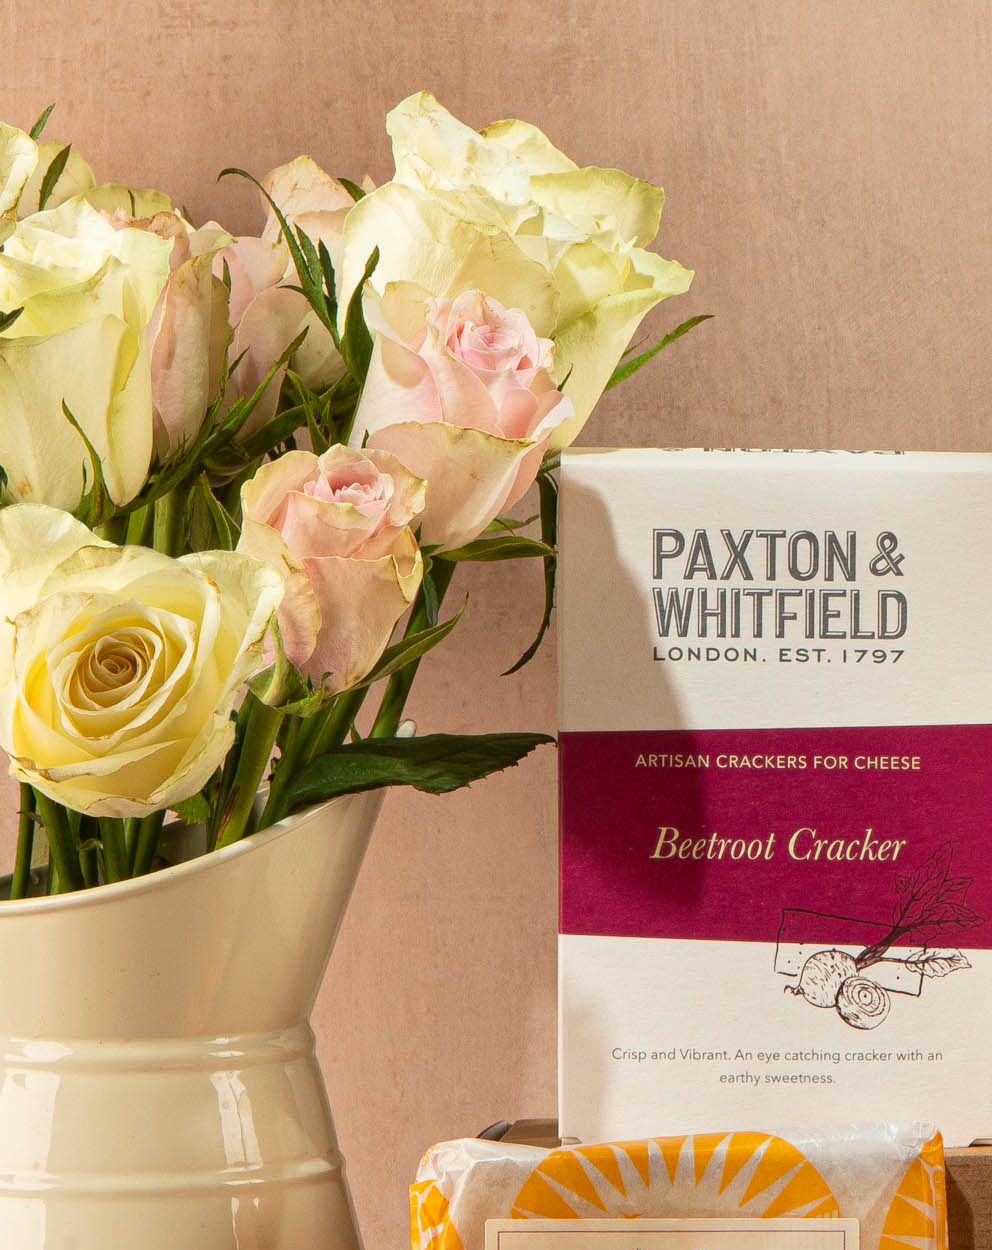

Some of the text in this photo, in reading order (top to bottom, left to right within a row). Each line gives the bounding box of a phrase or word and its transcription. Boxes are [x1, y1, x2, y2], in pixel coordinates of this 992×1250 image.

[652, 529, 904, 581] PAXTON &
[652, 587, 907, 639] WHITFIELD
[653, 647, 904, 664] LONDON. EST. 1797
[635, 754, 921, 770] ARTISAN CRACKERS FOR CHEESE
[650, 826, 906, 861] Beetroot Cracker
[612, 1048, 943, 1064] Crisp and Vibrant. An eye catching cracker with an
[720, 1071, 836, 1086] earthy sweetness.
